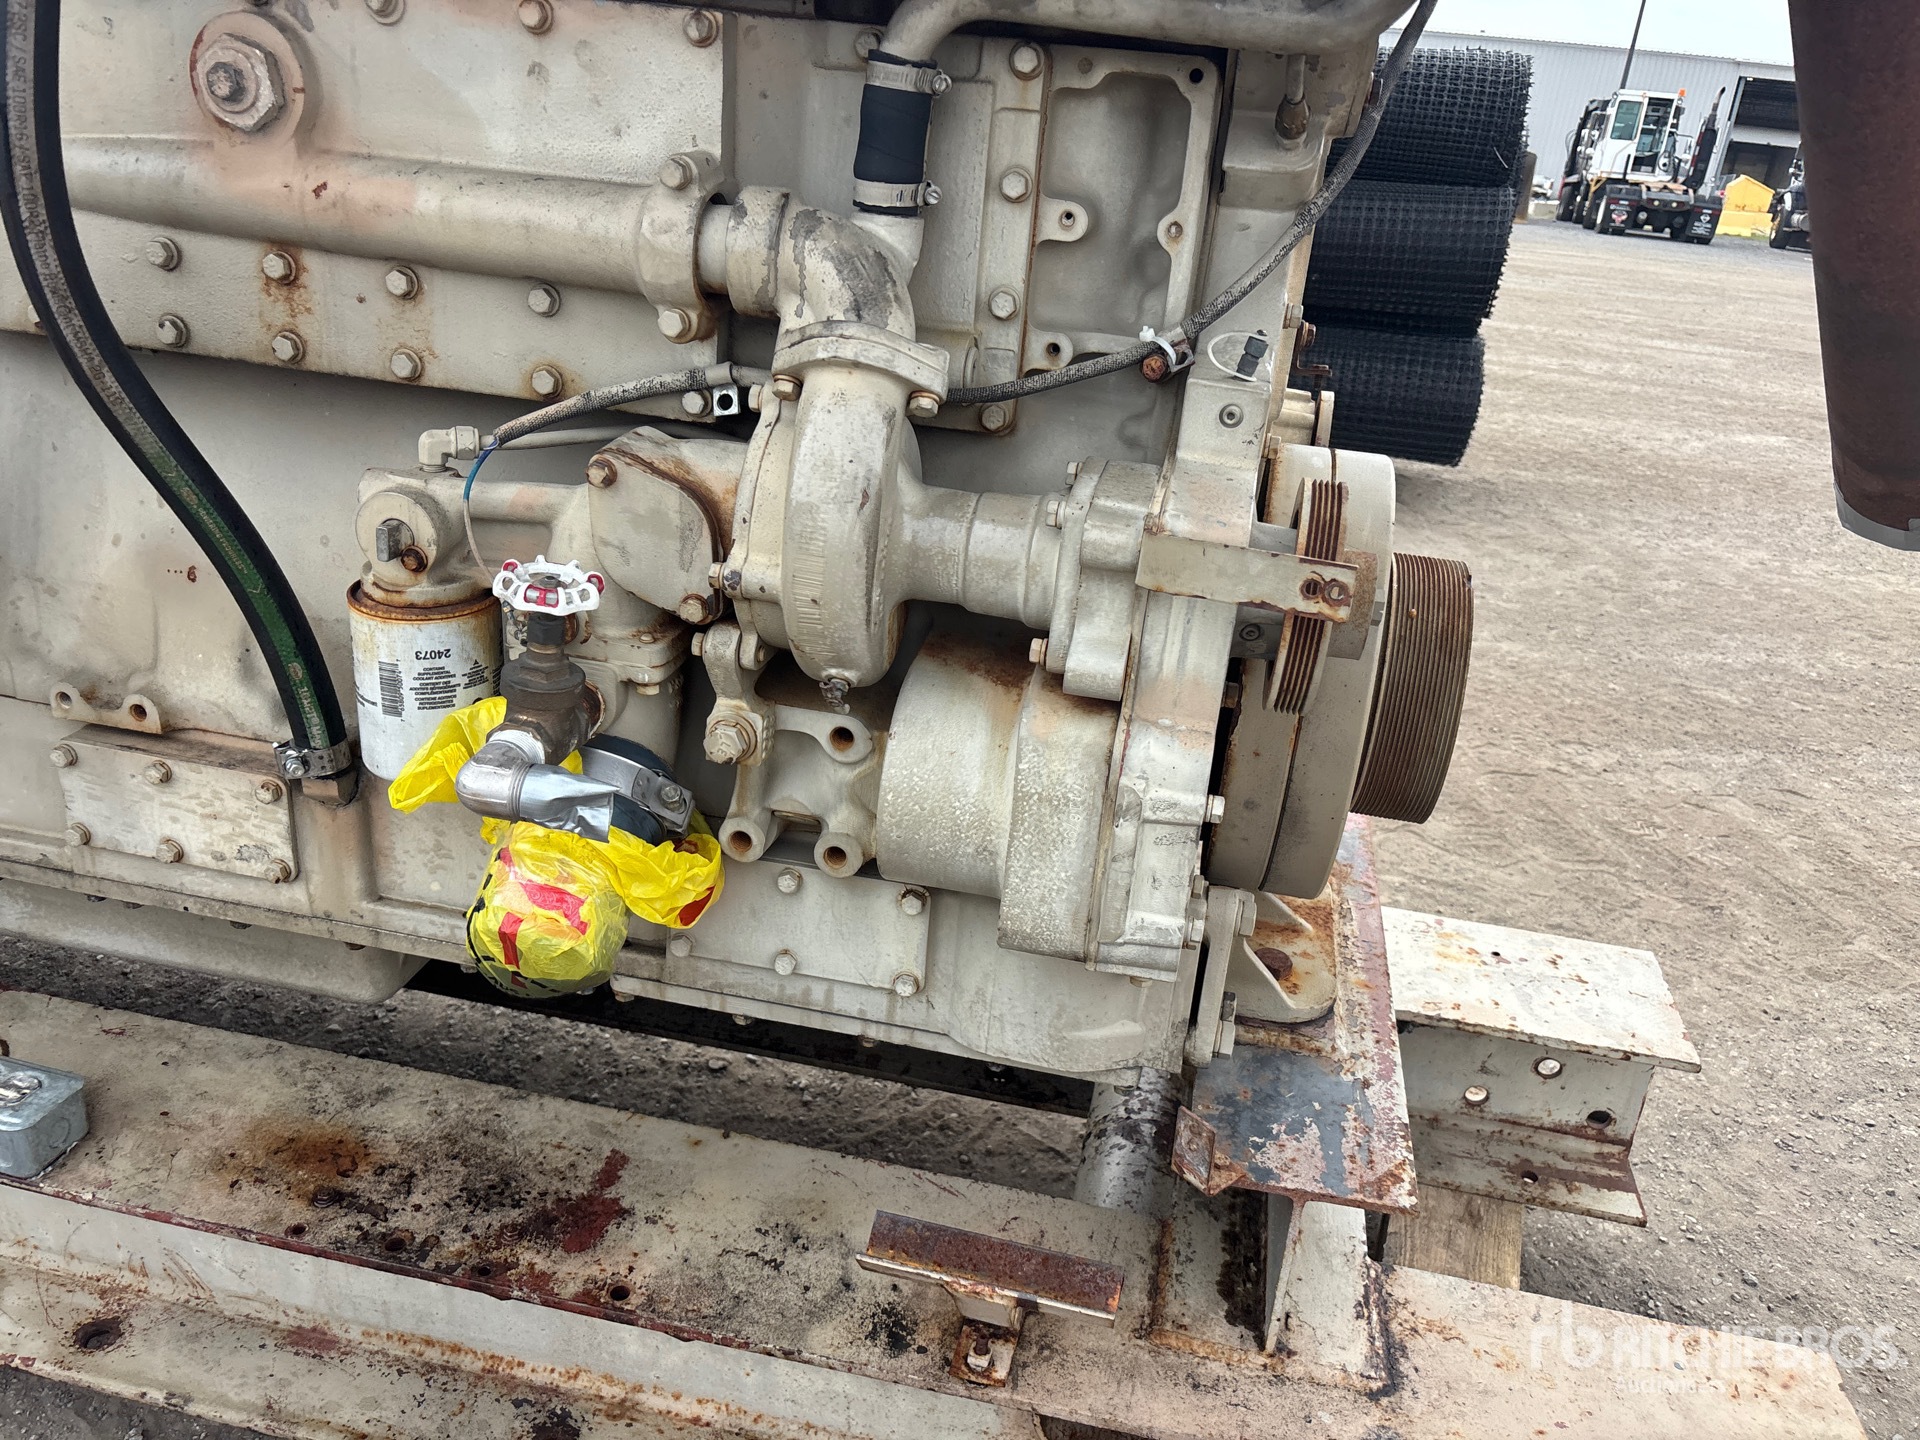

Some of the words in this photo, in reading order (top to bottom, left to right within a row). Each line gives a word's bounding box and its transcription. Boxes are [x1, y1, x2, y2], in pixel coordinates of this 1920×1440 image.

[12, 55, 27, 83] SAE
[12, 87, 29, 142] 100R16
[415, 648, 452, 660] 24073
